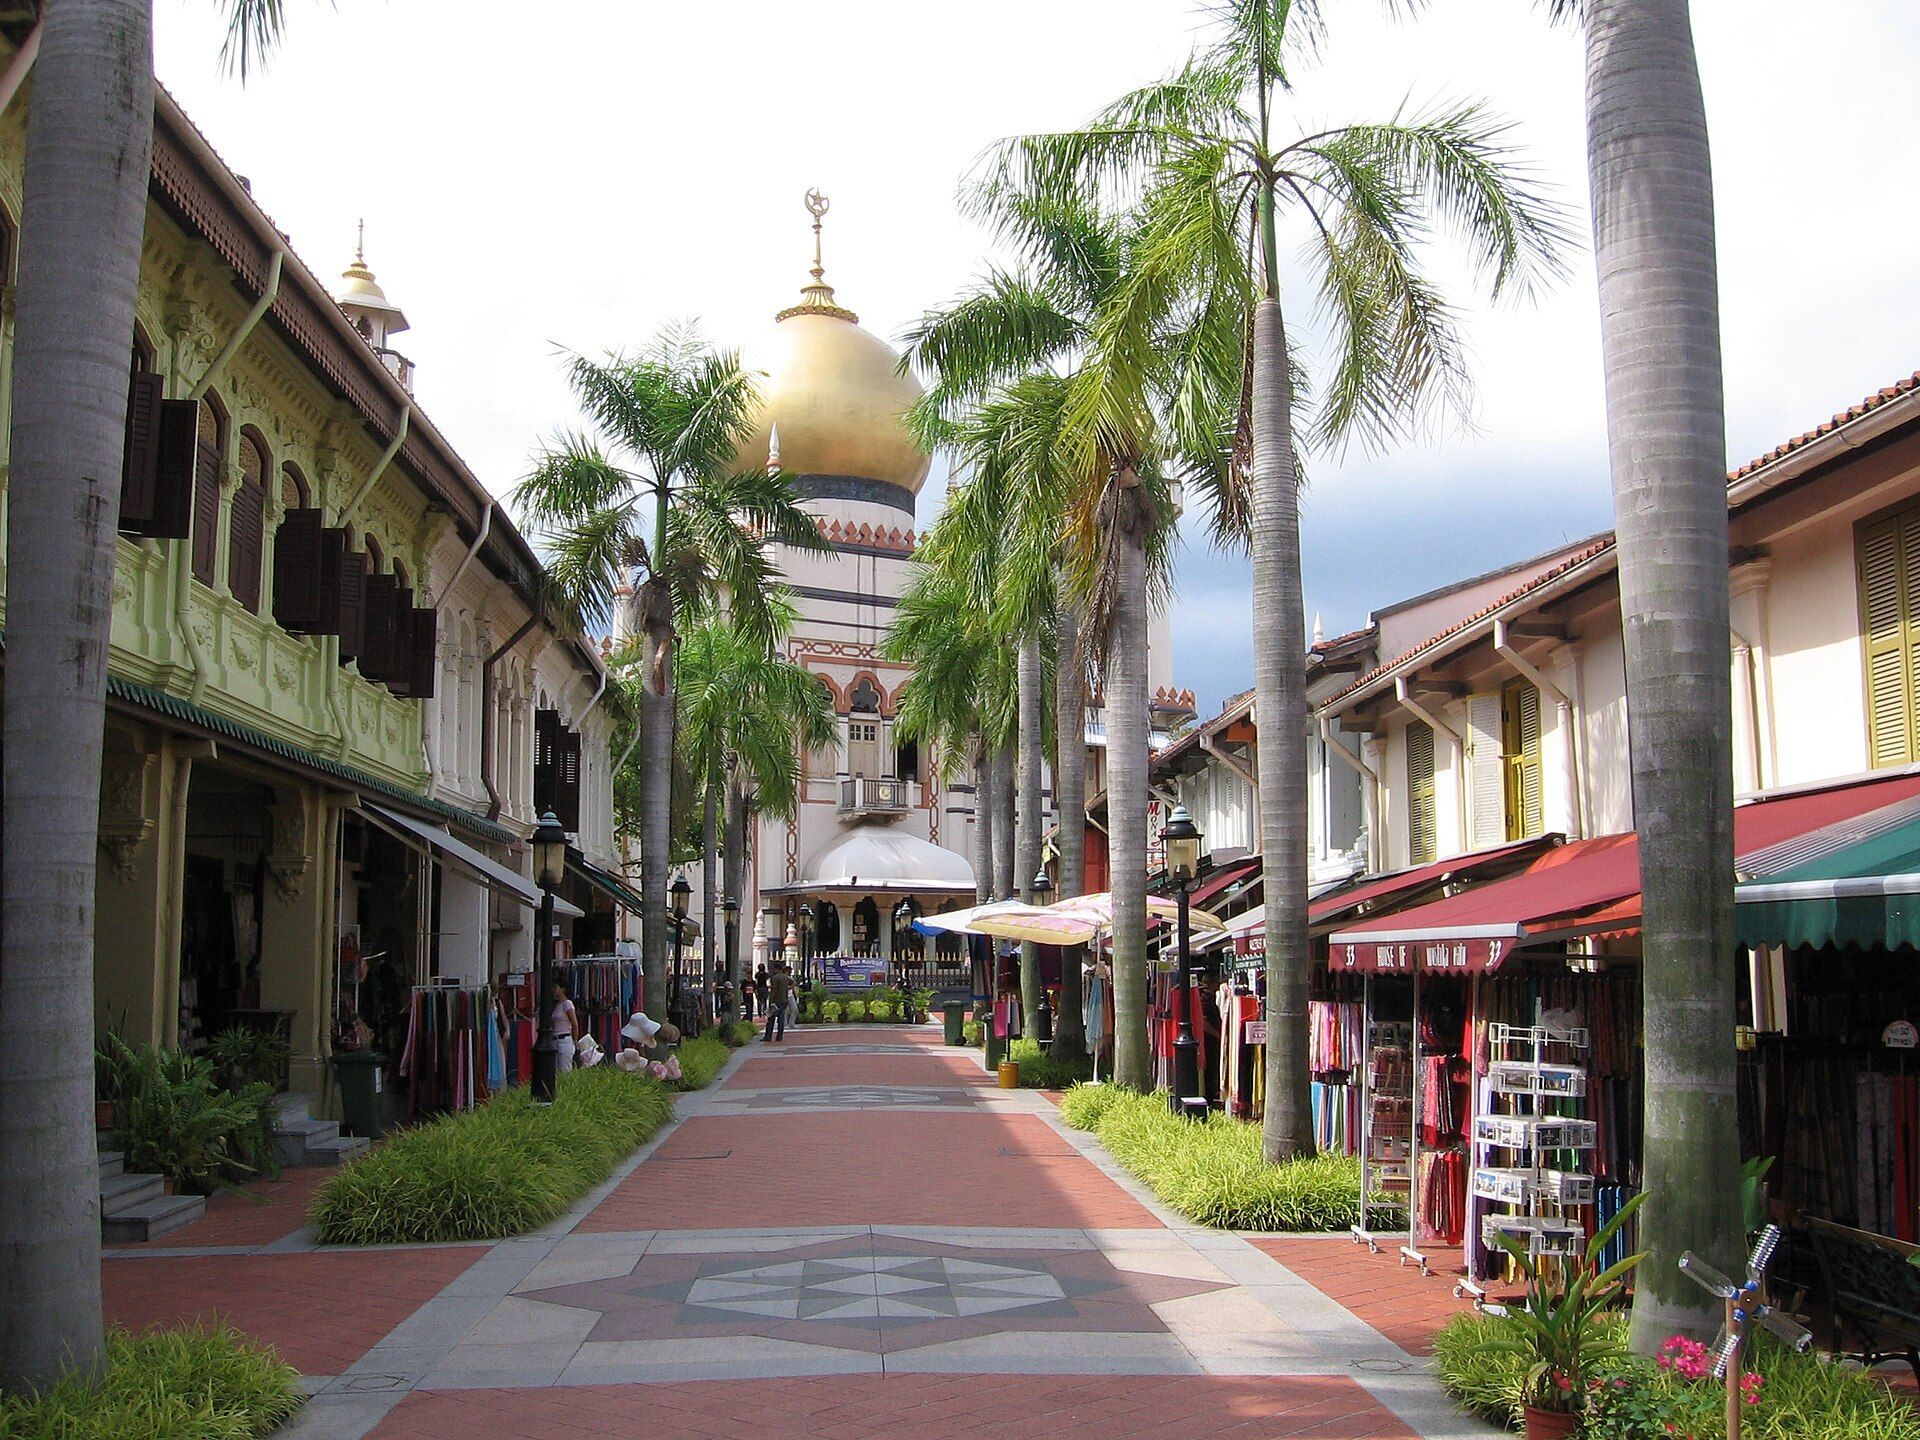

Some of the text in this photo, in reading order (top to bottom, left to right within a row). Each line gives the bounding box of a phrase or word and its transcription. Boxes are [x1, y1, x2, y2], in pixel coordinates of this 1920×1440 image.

[1345, 944, 1355, 967] 33
[1376, 945, 1395, 967] HOUSE
[1398, 945, 1406, 967] OF
